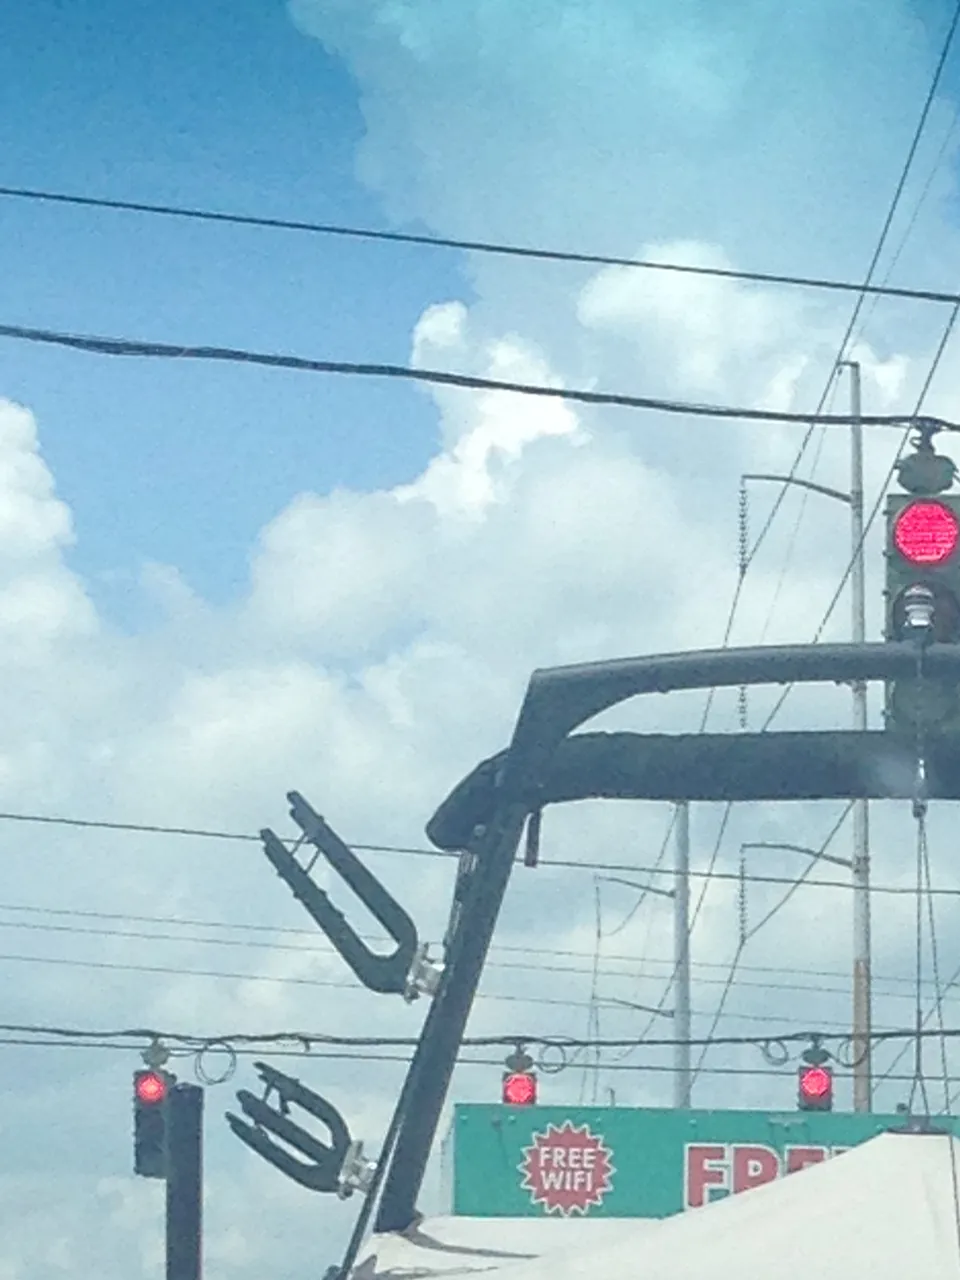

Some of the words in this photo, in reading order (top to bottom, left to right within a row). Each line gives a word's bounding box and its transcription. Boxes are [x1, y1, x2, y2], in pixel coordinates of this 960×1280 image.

[539, 1146, 597, 1169] FREE
[540, 1169, 593, 1192] WIFI
[684, 1143, 854, 1209] FR
